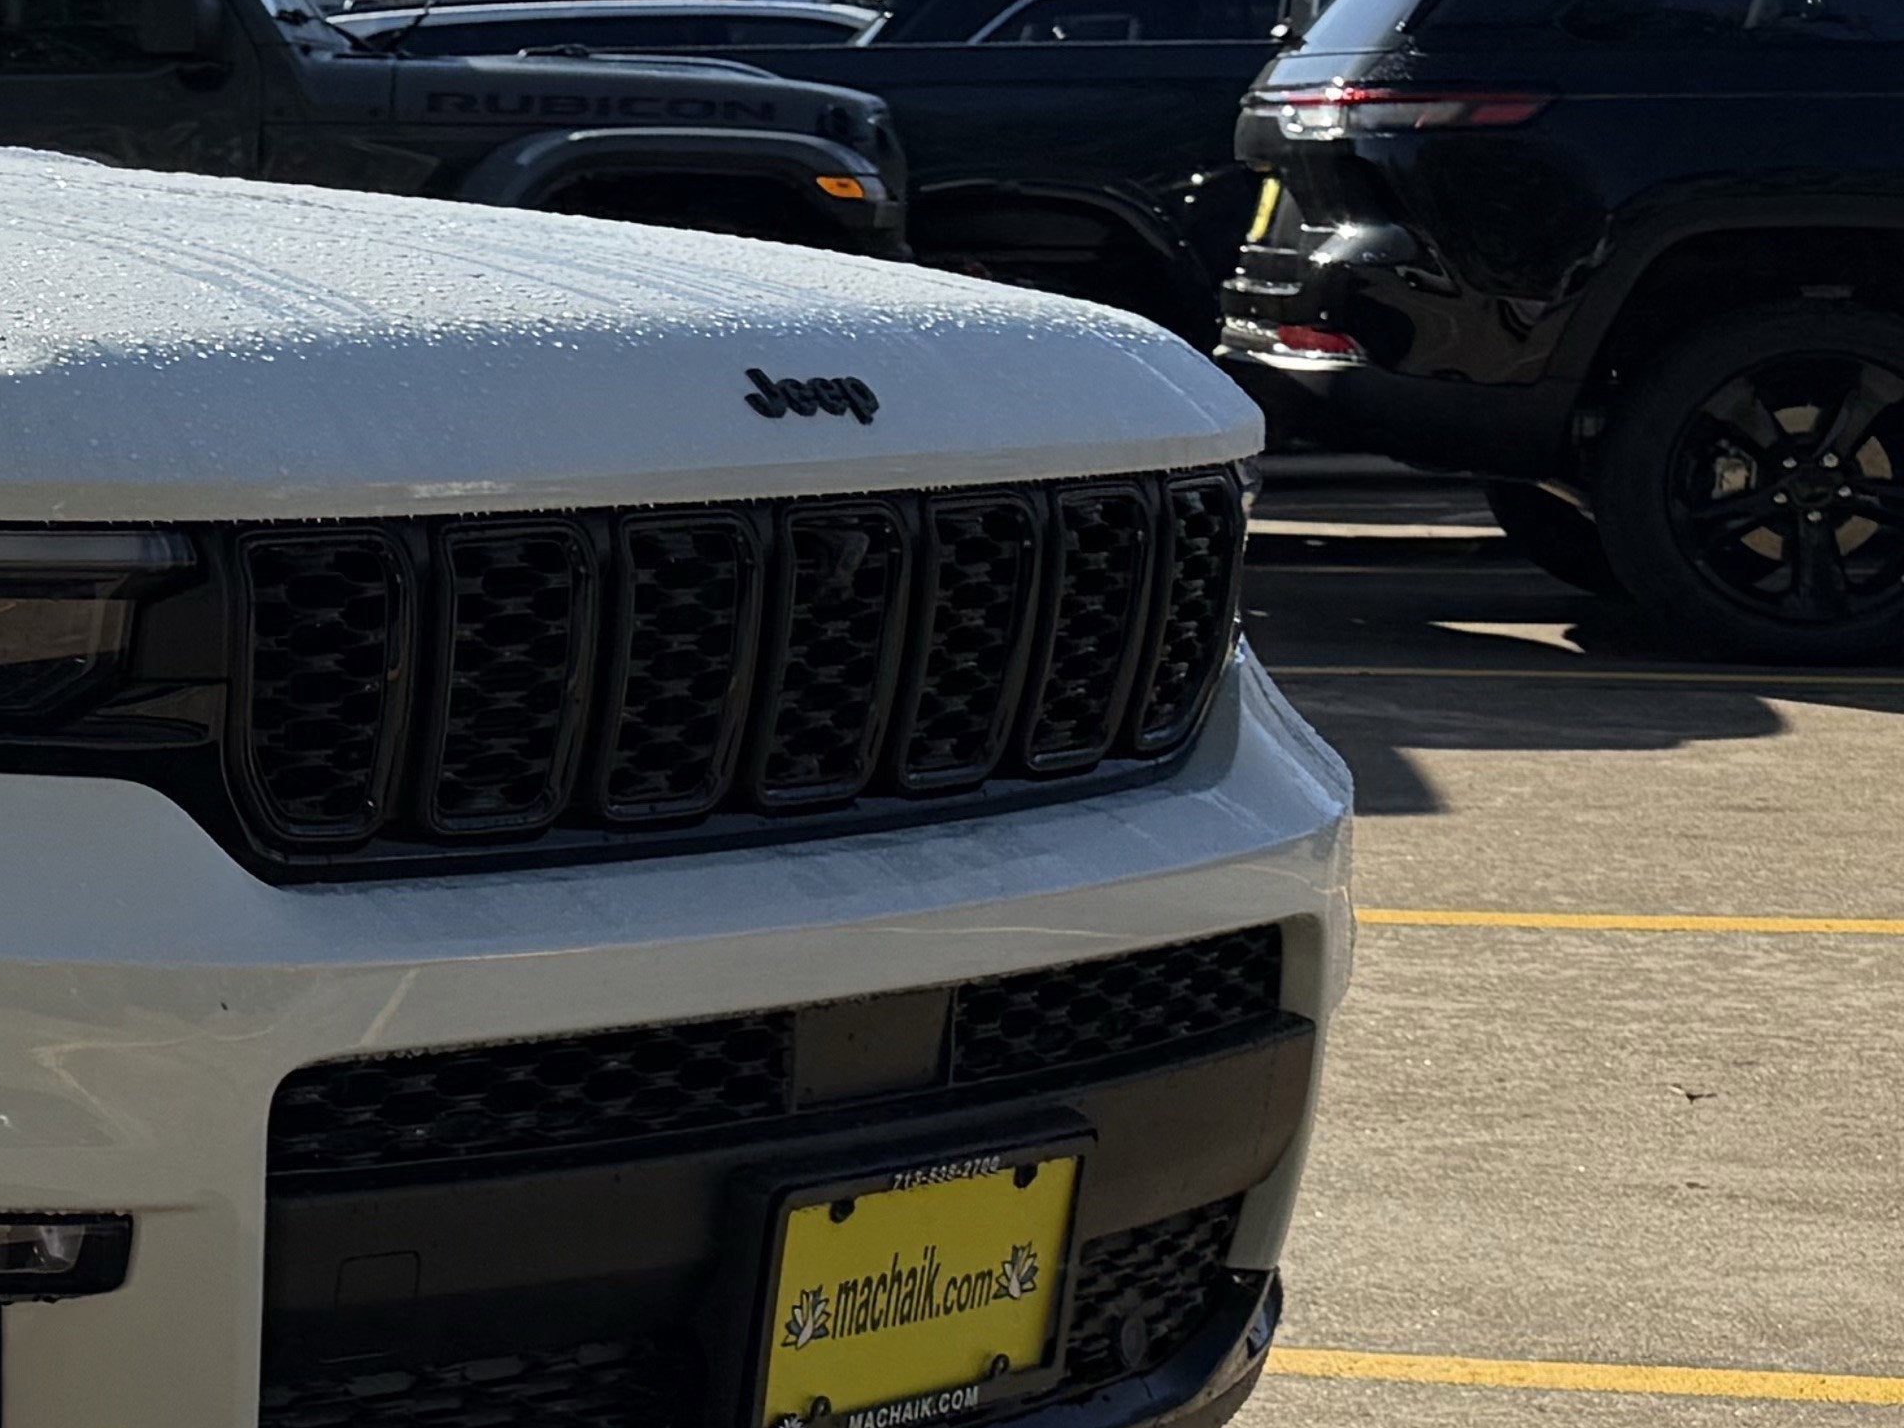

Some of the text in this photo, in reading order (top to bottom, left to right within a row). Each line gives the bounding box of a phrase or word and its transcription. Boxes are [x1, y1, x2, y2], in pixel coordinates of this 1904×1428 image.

[425, 91, 777, 122] RUBICON
[744, 368, 880, 426] Jeep
[831, 1245, 996, 1340] machaik.com
